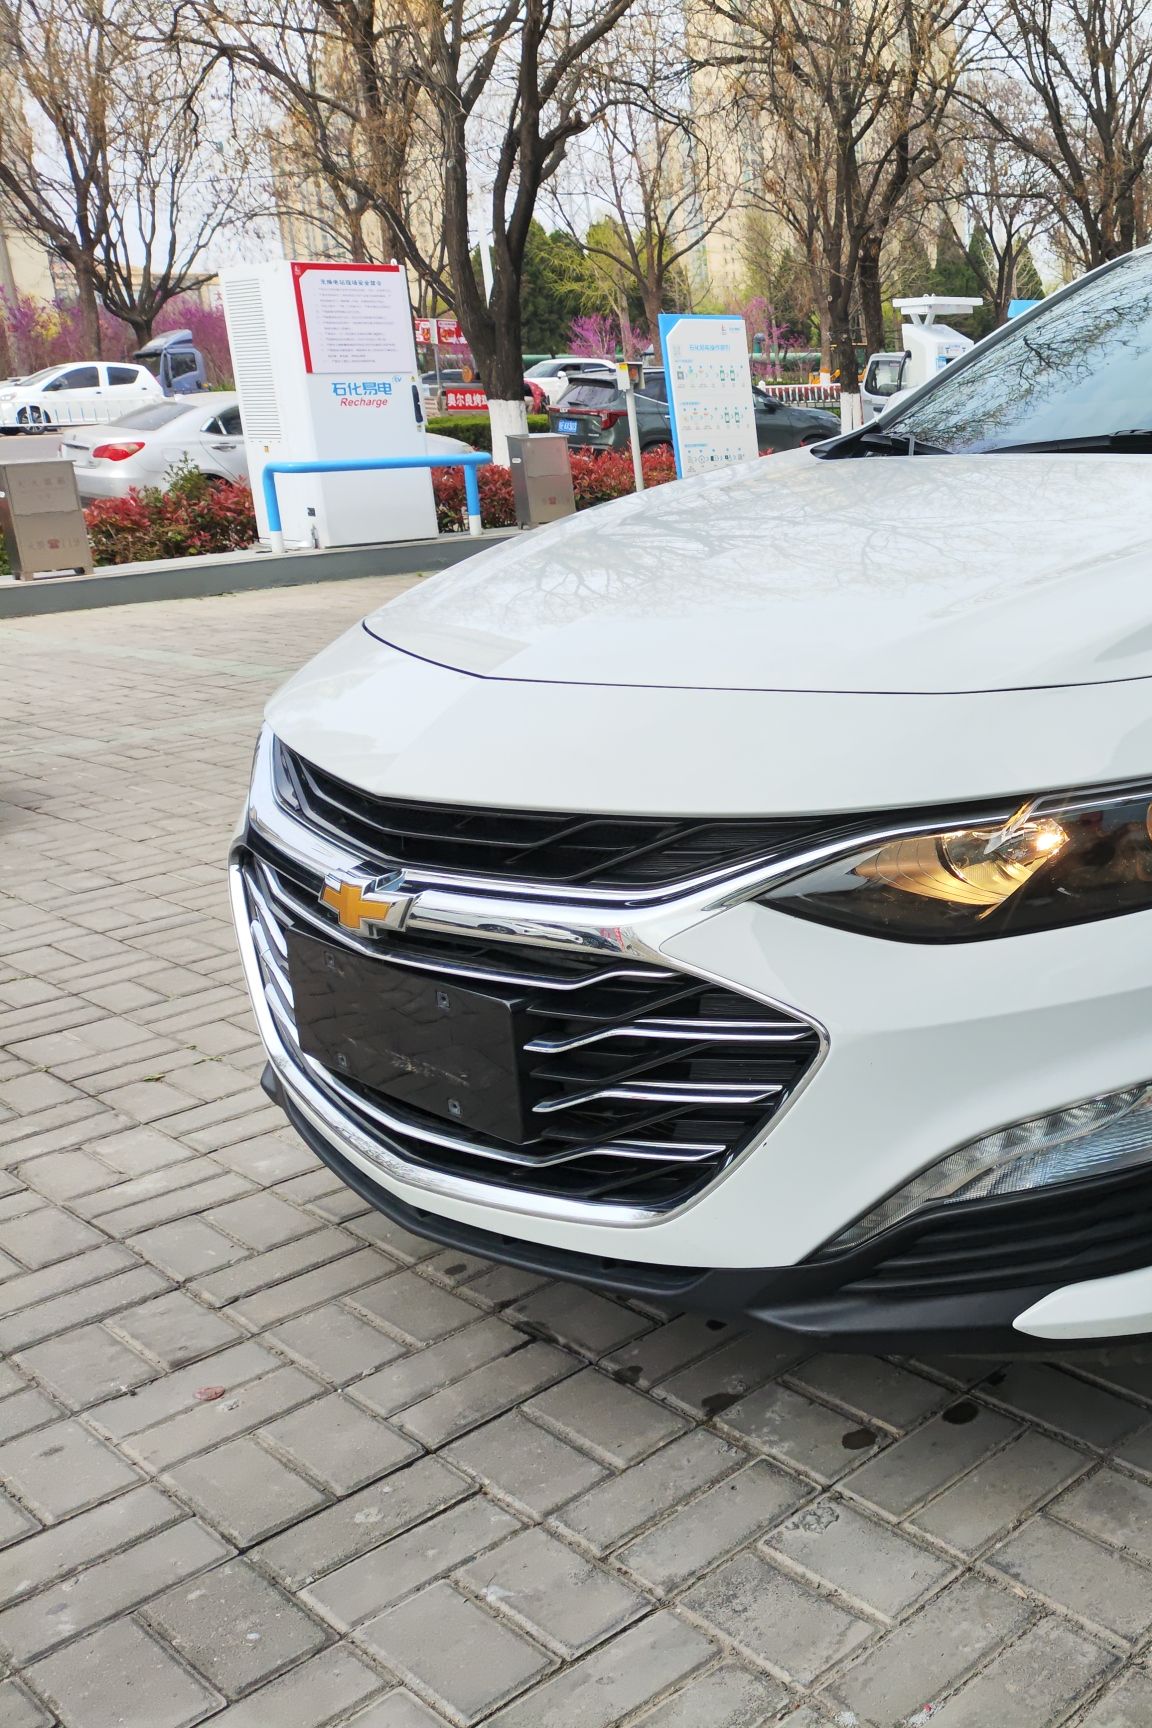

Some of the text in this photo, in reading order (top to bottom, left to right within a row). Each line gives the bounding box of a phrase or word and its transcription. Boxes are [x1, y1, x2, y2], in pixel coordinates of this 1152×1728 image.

[331, 381, 393, 397] 石化易电
[340, 397, 389, 409] Recharge
